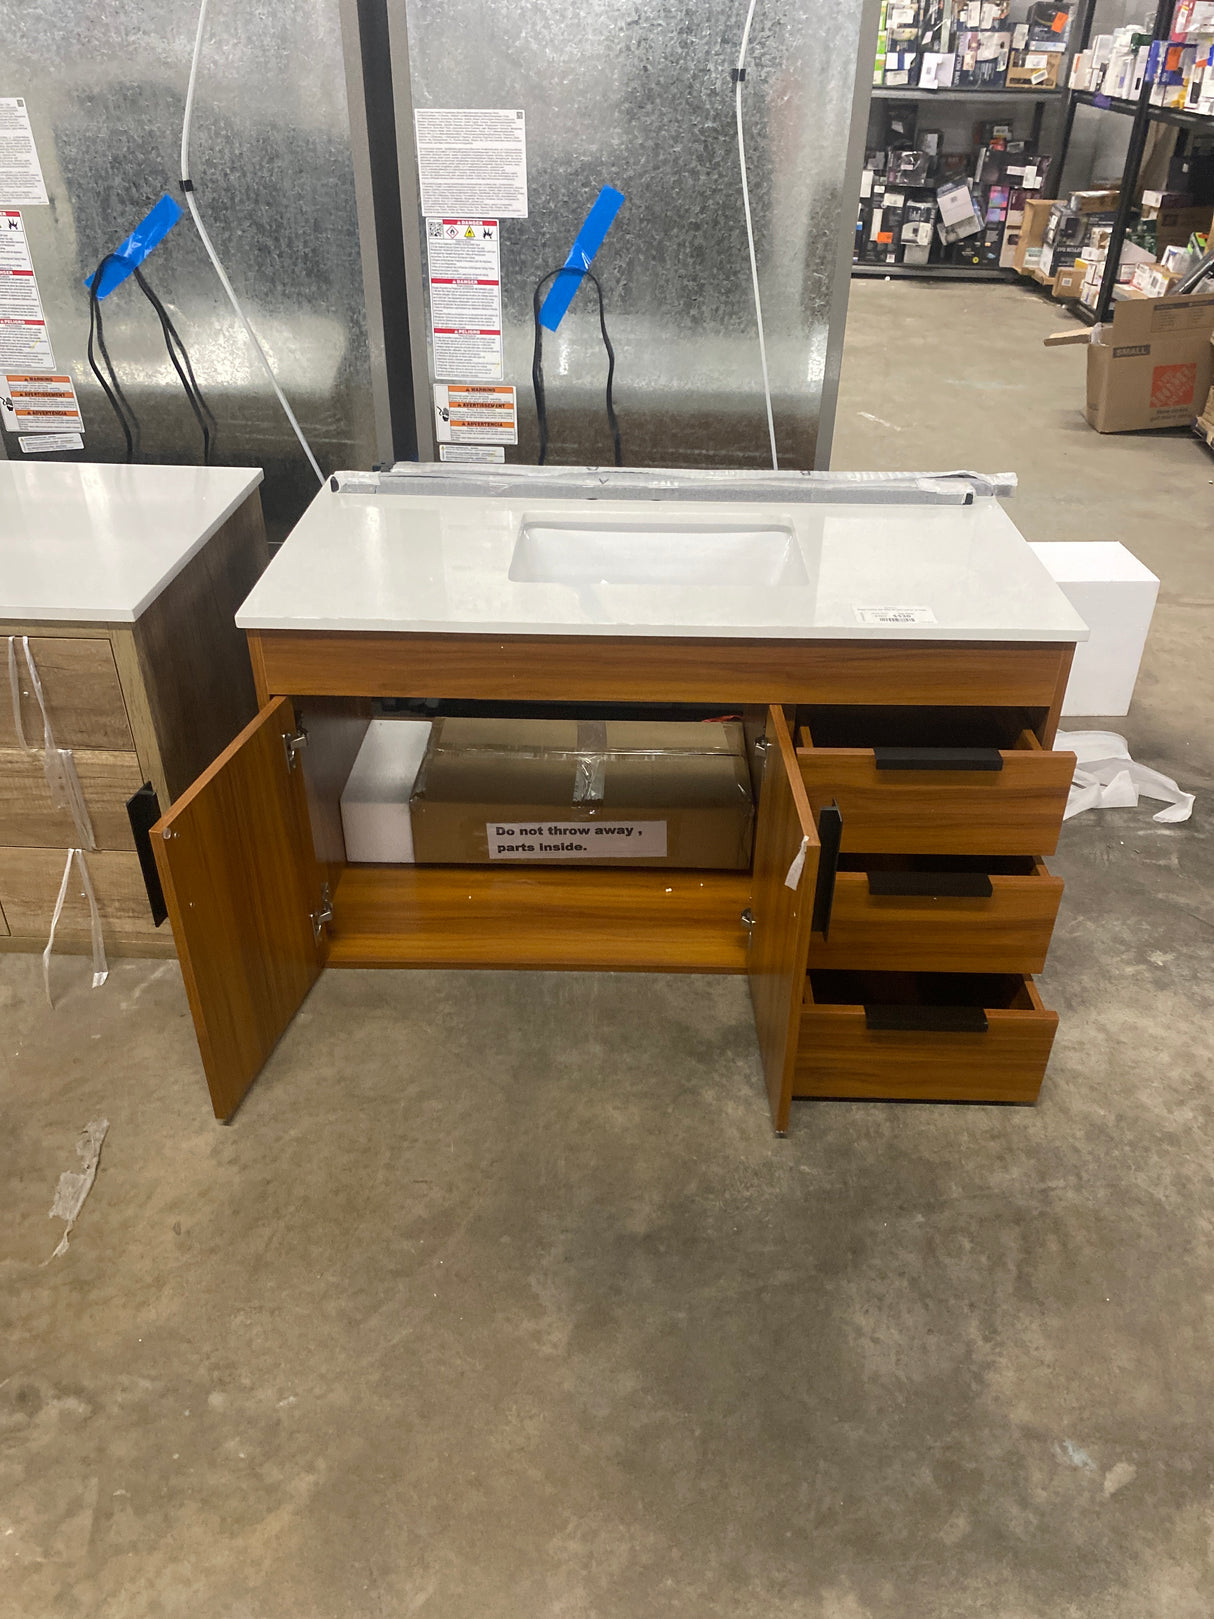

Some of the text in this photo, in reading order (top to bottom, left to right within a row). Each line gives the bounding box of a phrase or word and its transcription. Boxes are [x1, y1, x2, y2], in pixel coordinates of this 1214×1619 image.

[495, 826, 515, 836] Do
[519, 825, 544, 836] not
[547, 826, 590, 836] throw
[594, 826, 634, 837] away
[497, 842, 588, 854] parts inside.
